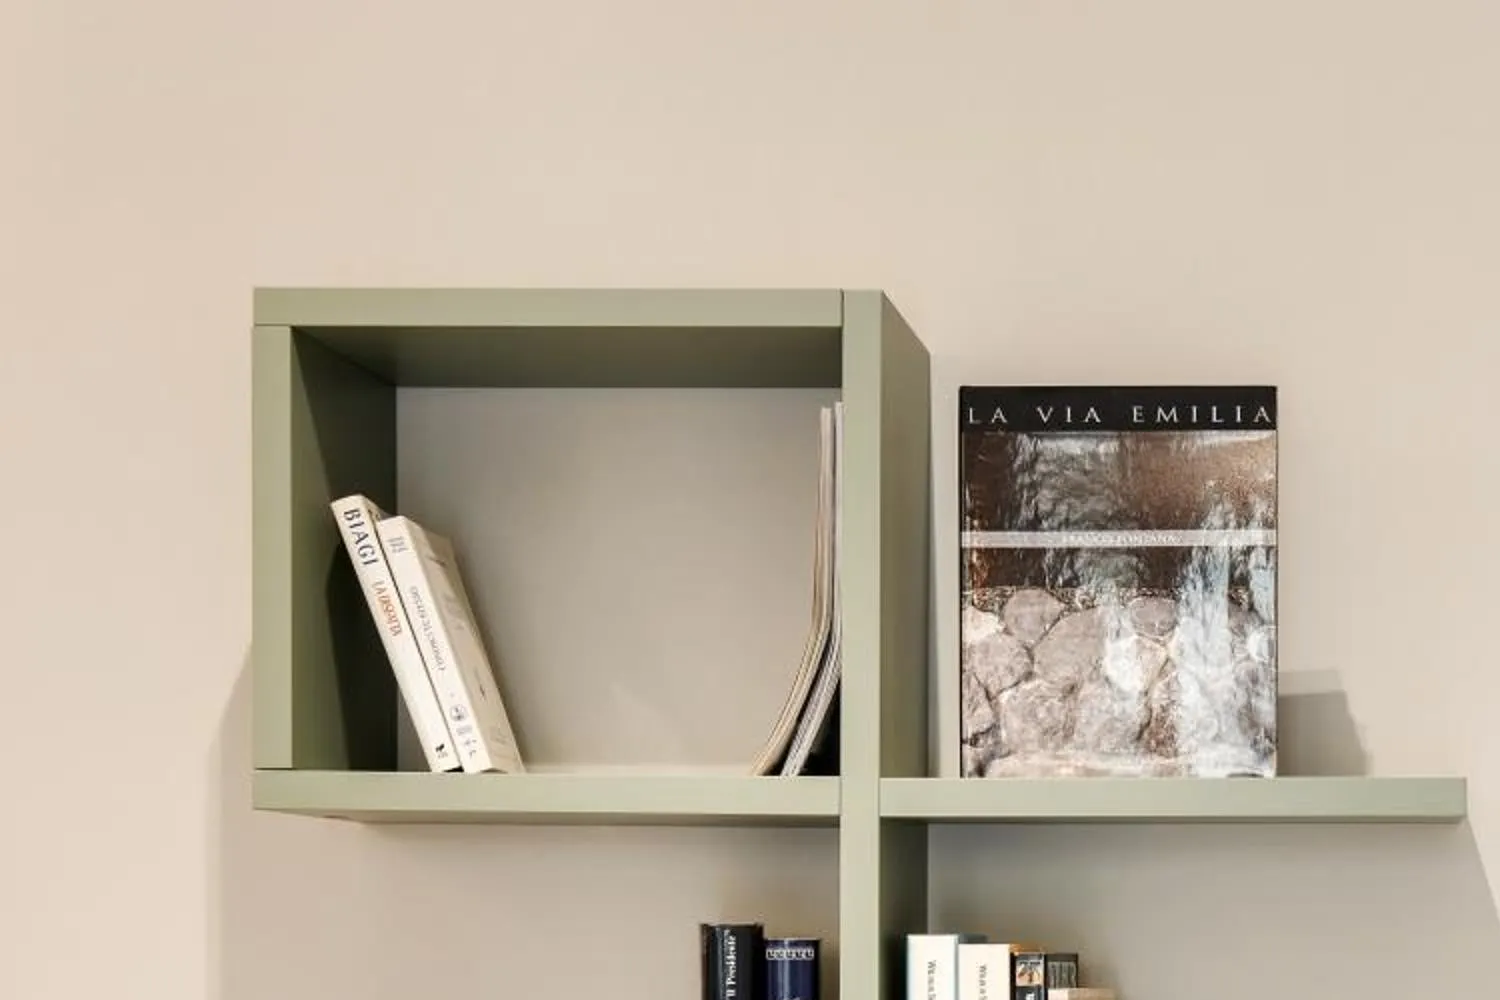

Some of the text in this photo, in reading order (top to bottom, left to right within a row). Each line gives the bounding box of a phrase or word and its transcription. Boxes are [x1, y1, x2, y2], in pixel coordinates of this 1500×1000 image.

[968, 405, 1272, 424] LA VIA EMILIA
[343, 508, 379, 565] BIAGI
